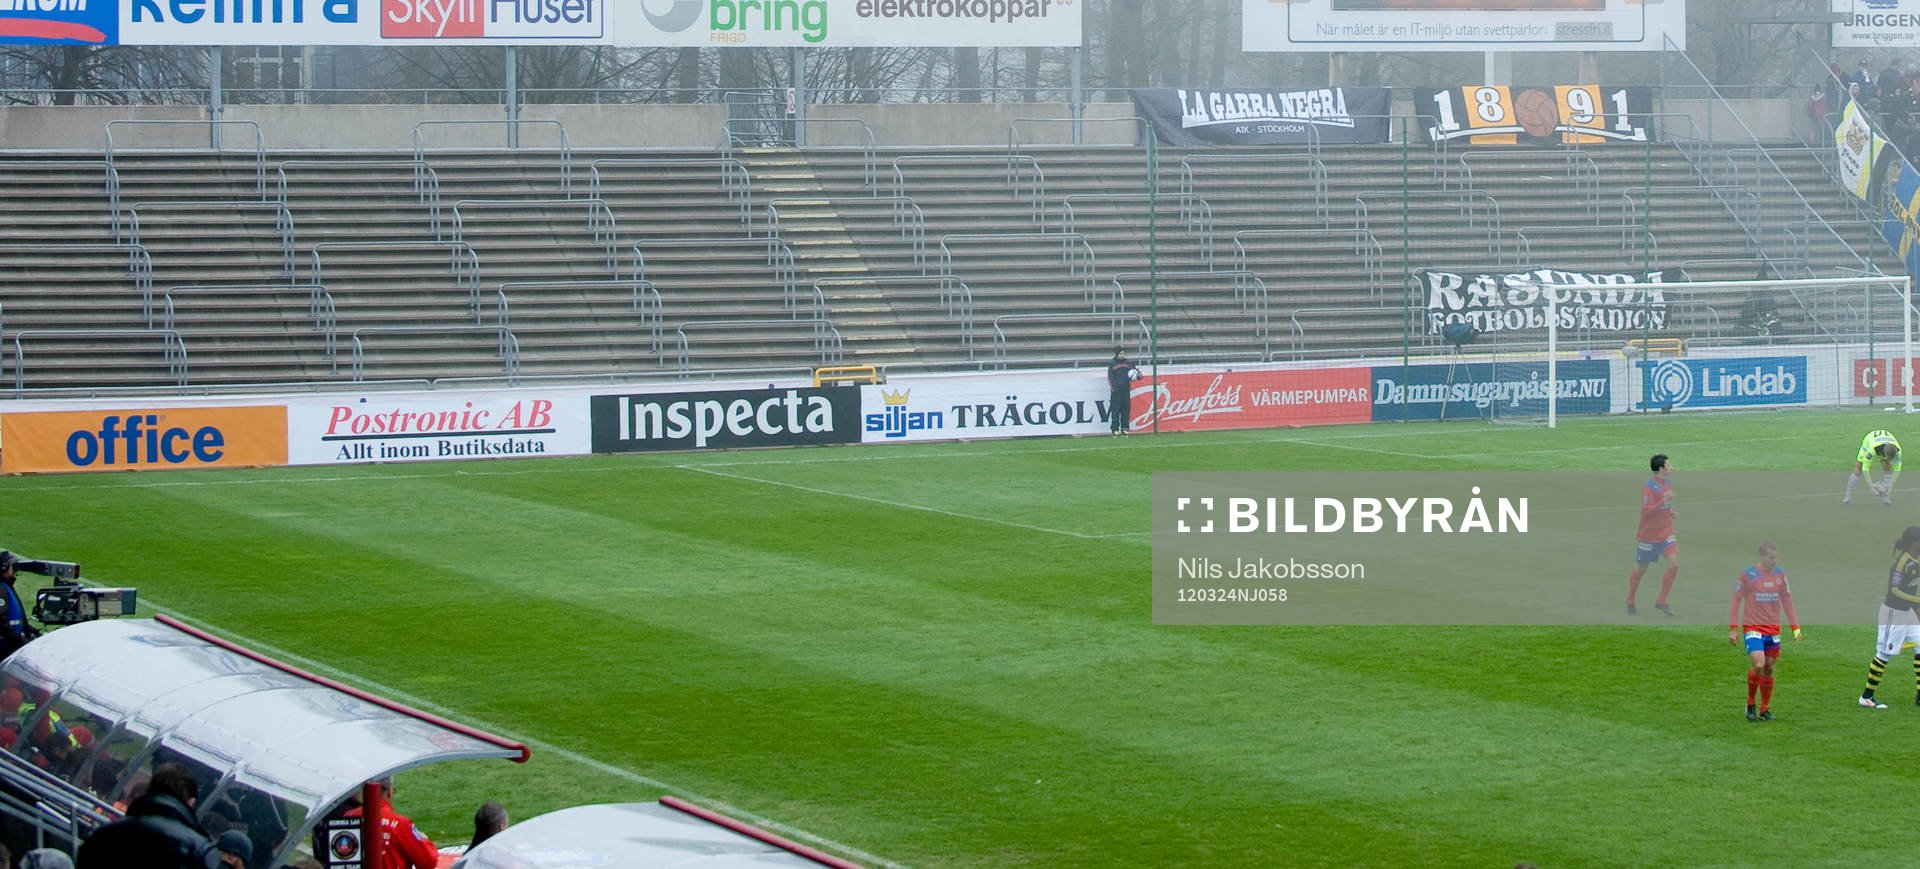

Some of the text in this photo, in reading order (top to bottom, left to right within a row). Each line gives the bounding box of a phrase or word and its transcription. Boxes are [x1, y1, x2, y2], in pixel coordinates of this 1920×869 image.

[710, 0, 828, 43] bring
[856, 0, 1053, 23] elektrokoppar
[710, 32, 746, 43] FRIGO
[1316, 22, 1339, 36] När
[1343, 22, 1374, 36] målet
[1378, 24, 1389, 36] är
[1393, 26, 1406, 36] en
[1410, 22, 1451, 39] IT-miljö
[1455, 24, 1480, 36] utan
[1177, 87, 1350, 121] LA GARRA NEGRA
[1235, 126, 1249, 134] AIK
[1257, 125, 1305, 134] STOCKHOLM
[1702, 365, 1797, 397] Lindab
[325, 399, 553, 435] Postronic AB
[1130, 373, 1369, 430] Danfoss VÄRMEPUMPAR
[619, 390, 834, 447] Inspecta
[866, 405, 943, 437] siljan
[66, 414, 225, 466] office
[336, 437, 545, 460] Allt inom Butiksdata
